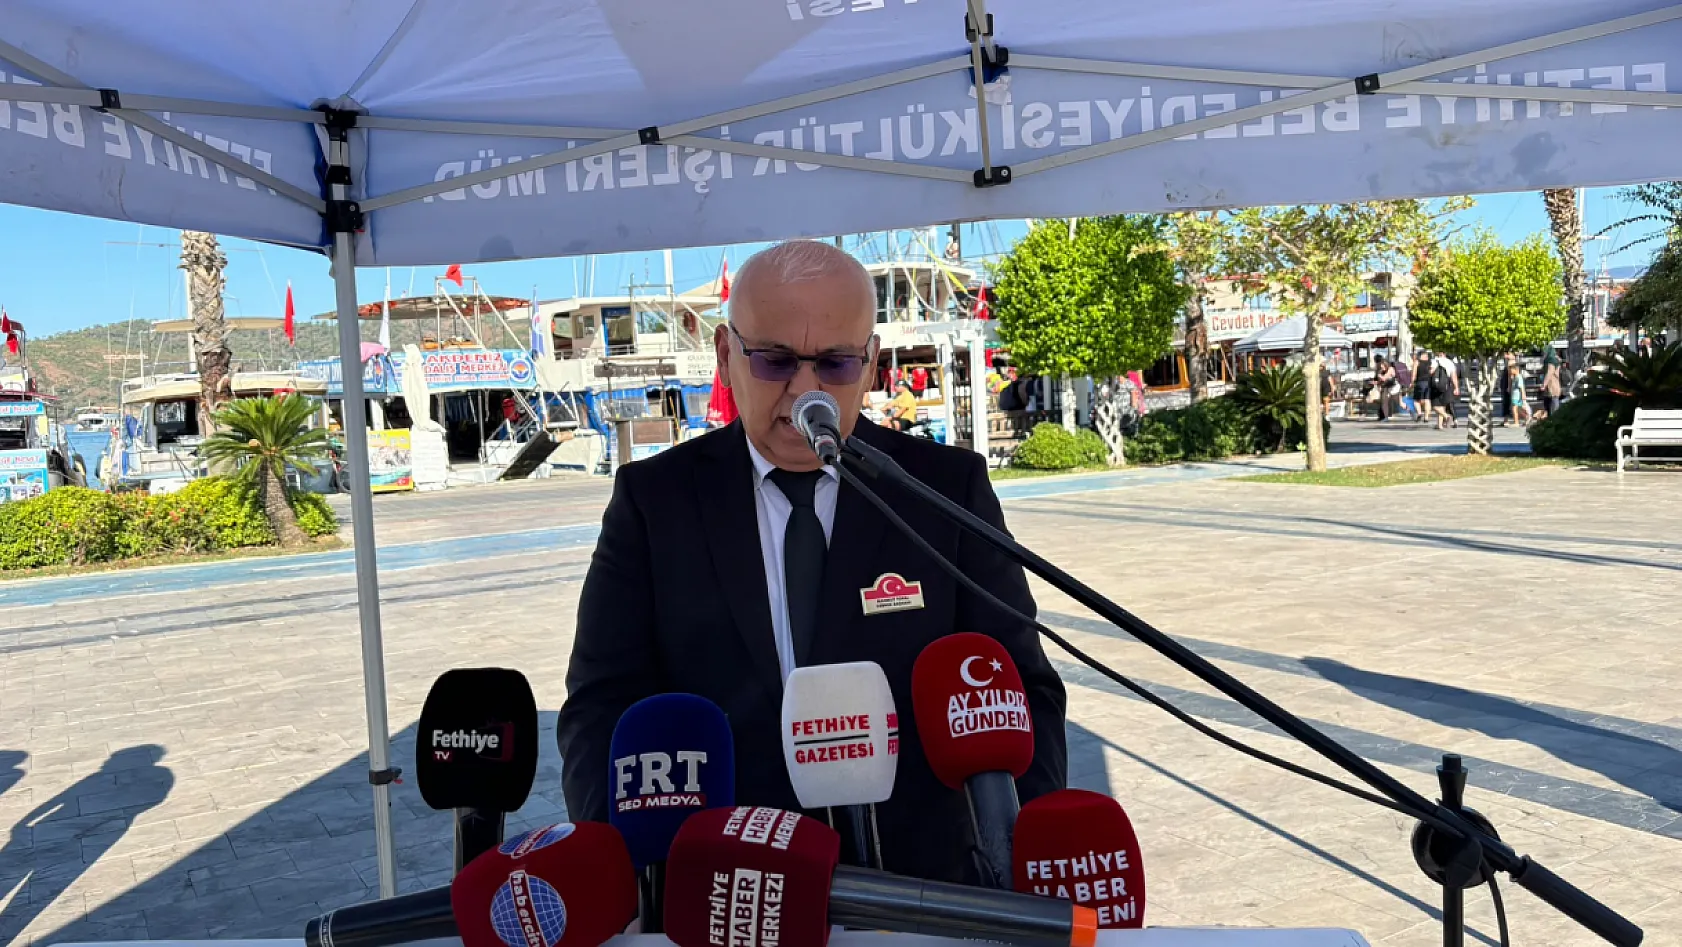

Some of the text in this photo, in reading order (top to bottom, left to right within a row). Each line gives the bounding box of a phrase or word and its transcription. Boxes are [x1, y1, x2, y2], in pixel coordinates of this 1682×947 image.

[1212, 313, 1255, 331] Cevdet
[949, 691, 971, 714] AY
[951, 709, 1030, 734] GÜNDEM
[432, 729, 500, 754] Fethiye
[434, 750, 450, 760] TV
[614, 750, 708, 800] FRT
[645, 795, 702, 807] MEDYA
[1026, 850, 1130, 880] FETHİYE
[708, 871, 729, 945] FETHİYE
[1098, 896, 1136, 925] ENİ
